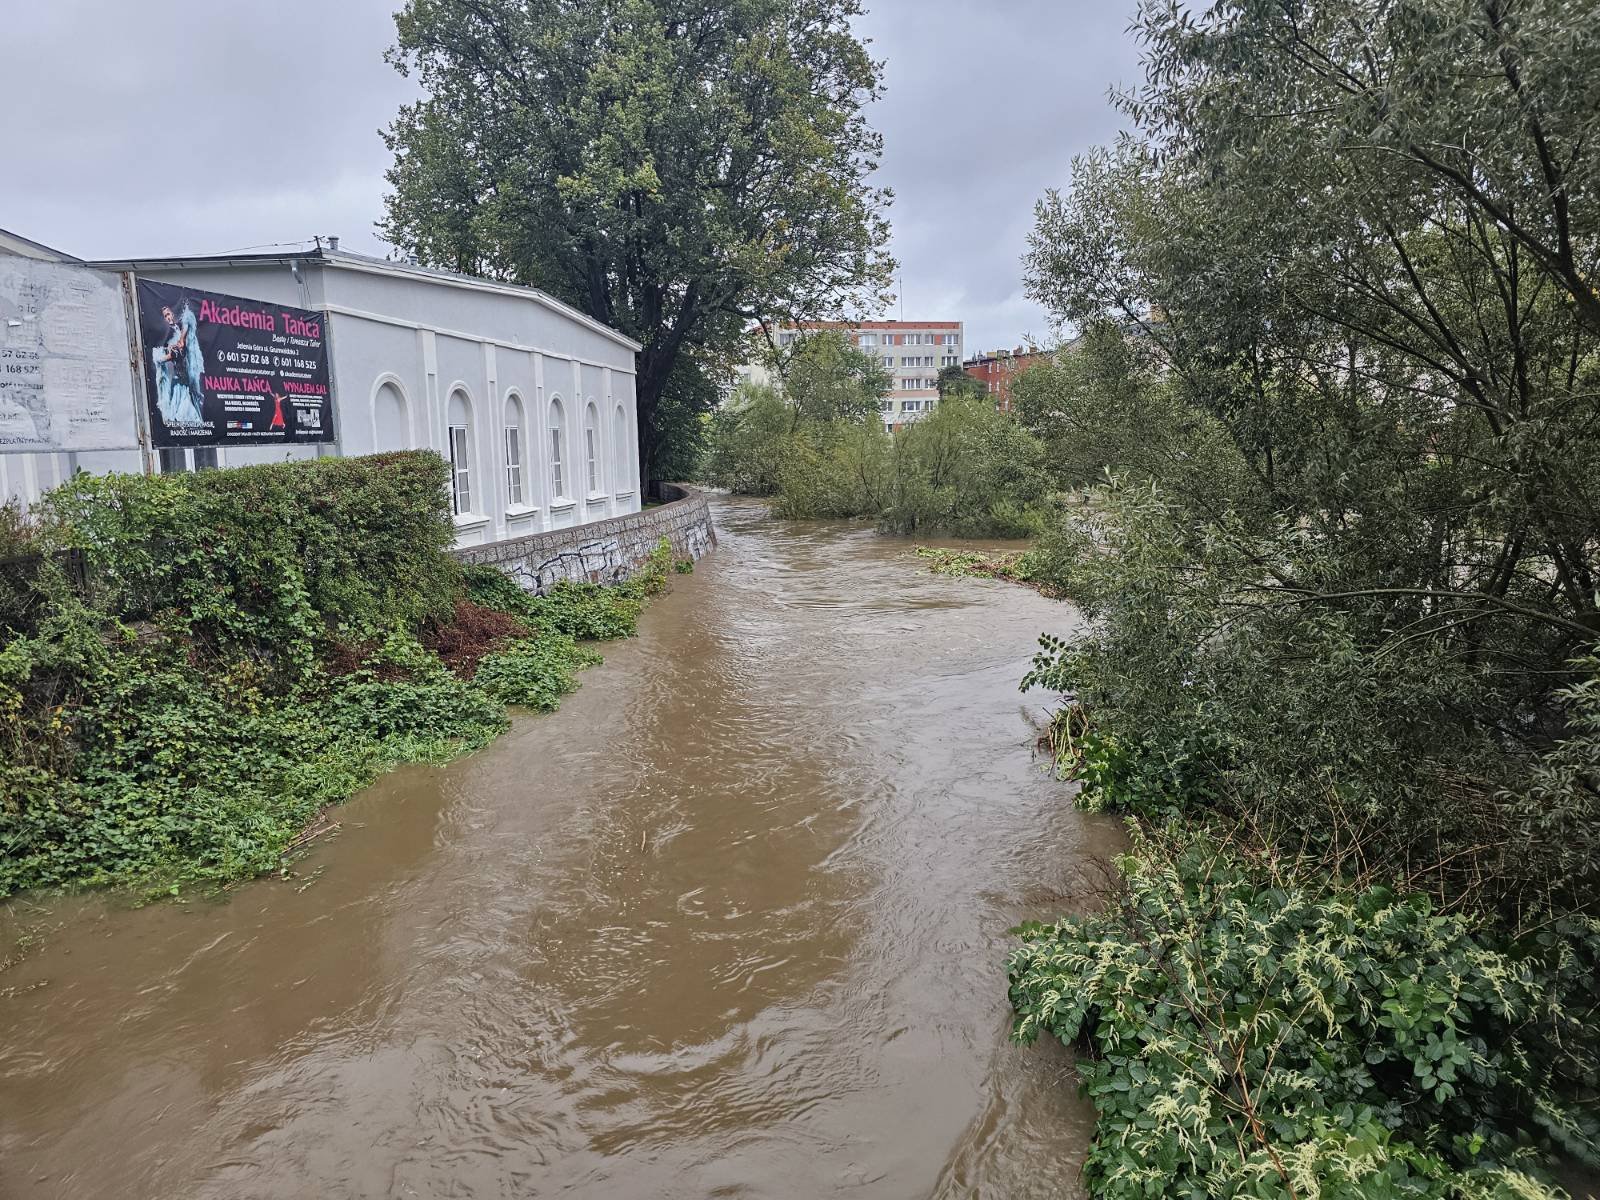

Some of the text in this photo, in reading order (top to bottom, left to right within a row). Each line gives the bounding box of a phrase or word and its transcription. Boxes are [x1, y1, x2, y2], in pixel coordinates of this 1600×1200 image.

[199, 299, 320, 338] Akademia Tańca
[226, 351, 270, 365] 601 57 82 68
[281, 357, 317, 370] 601 168 525
[6, 364, 22, 374] 168
[204, 375, 272, 393] NAUKA TAŃCA
[283, 381, 315, 394] WYNAJEM
